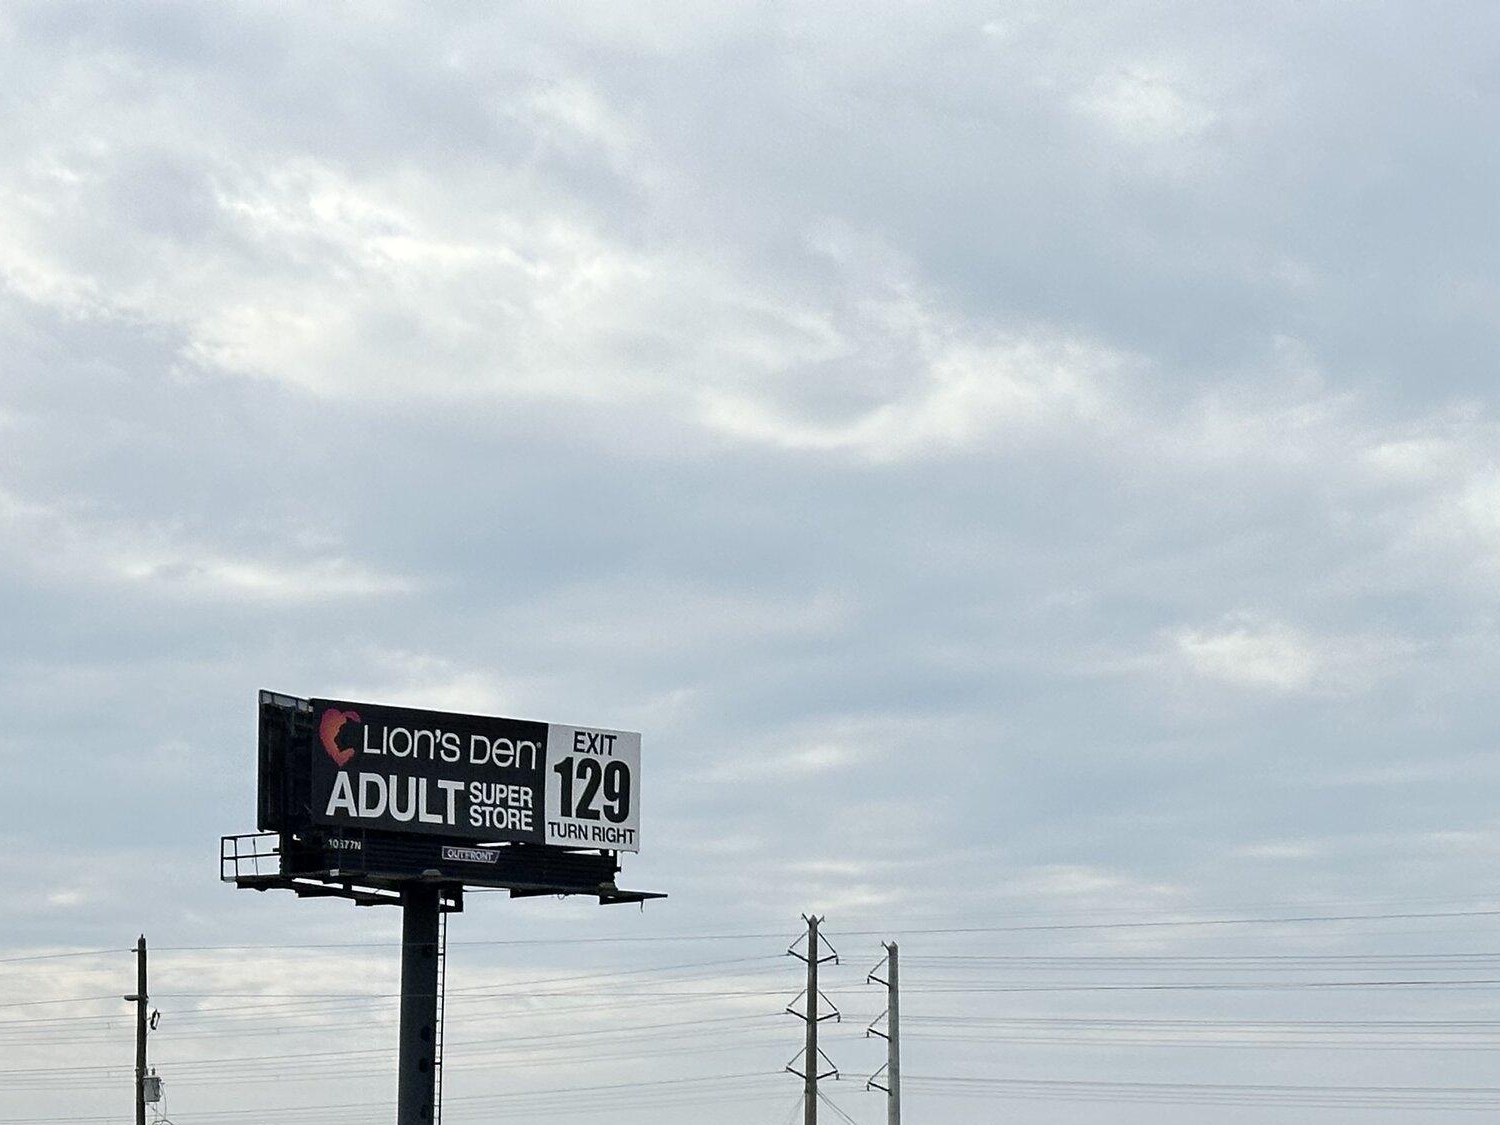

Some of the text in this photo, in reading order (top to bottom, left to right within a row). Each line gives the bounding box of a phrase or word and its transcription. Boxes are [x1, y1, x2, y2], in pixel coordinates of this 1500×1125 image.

[573, 731, 617, 756] EXIT
[325, 771, 465, 825] ADULT
[469, 781, 533, 808] SUPER
[553, 756, 631, 824] 129
[469, 806, 534, 832] STORE
[548, 821, 635, 844] TURN RIGHT
[447, 849, 494, 861] OUTFRONT
